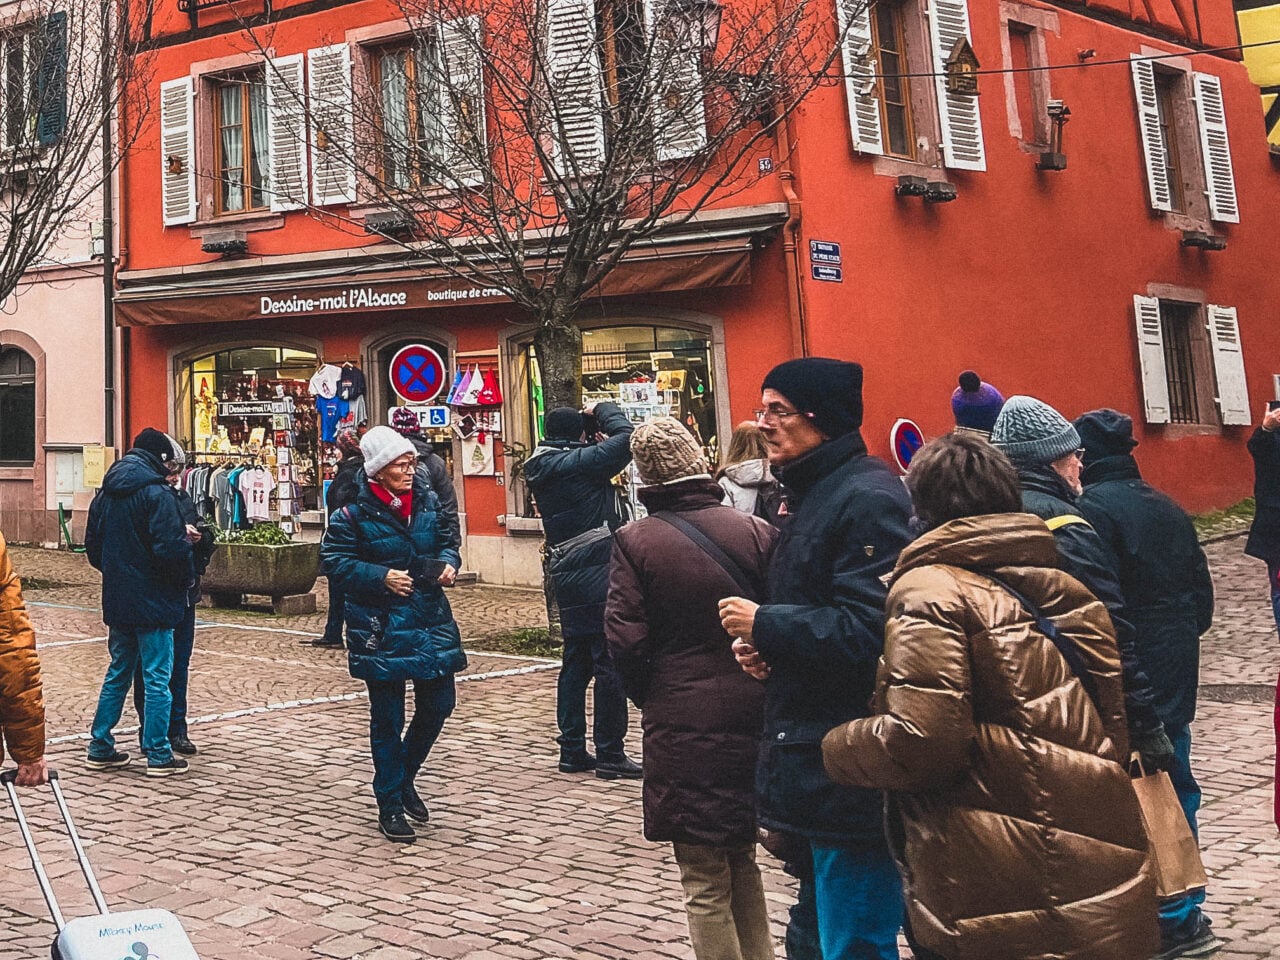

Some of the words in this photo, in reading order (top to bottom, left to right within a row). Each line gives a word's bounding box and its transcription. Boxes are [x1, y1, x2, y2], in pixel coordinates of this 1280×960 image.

[260, 291, 347, 315] Dessine-moi
[349, 288, 407, 309] l'Alsace
[427, 288, 468, 302] boutique
[469, 287, 481, 298] de
[228, 403, 264, 414] Dessine-moi
